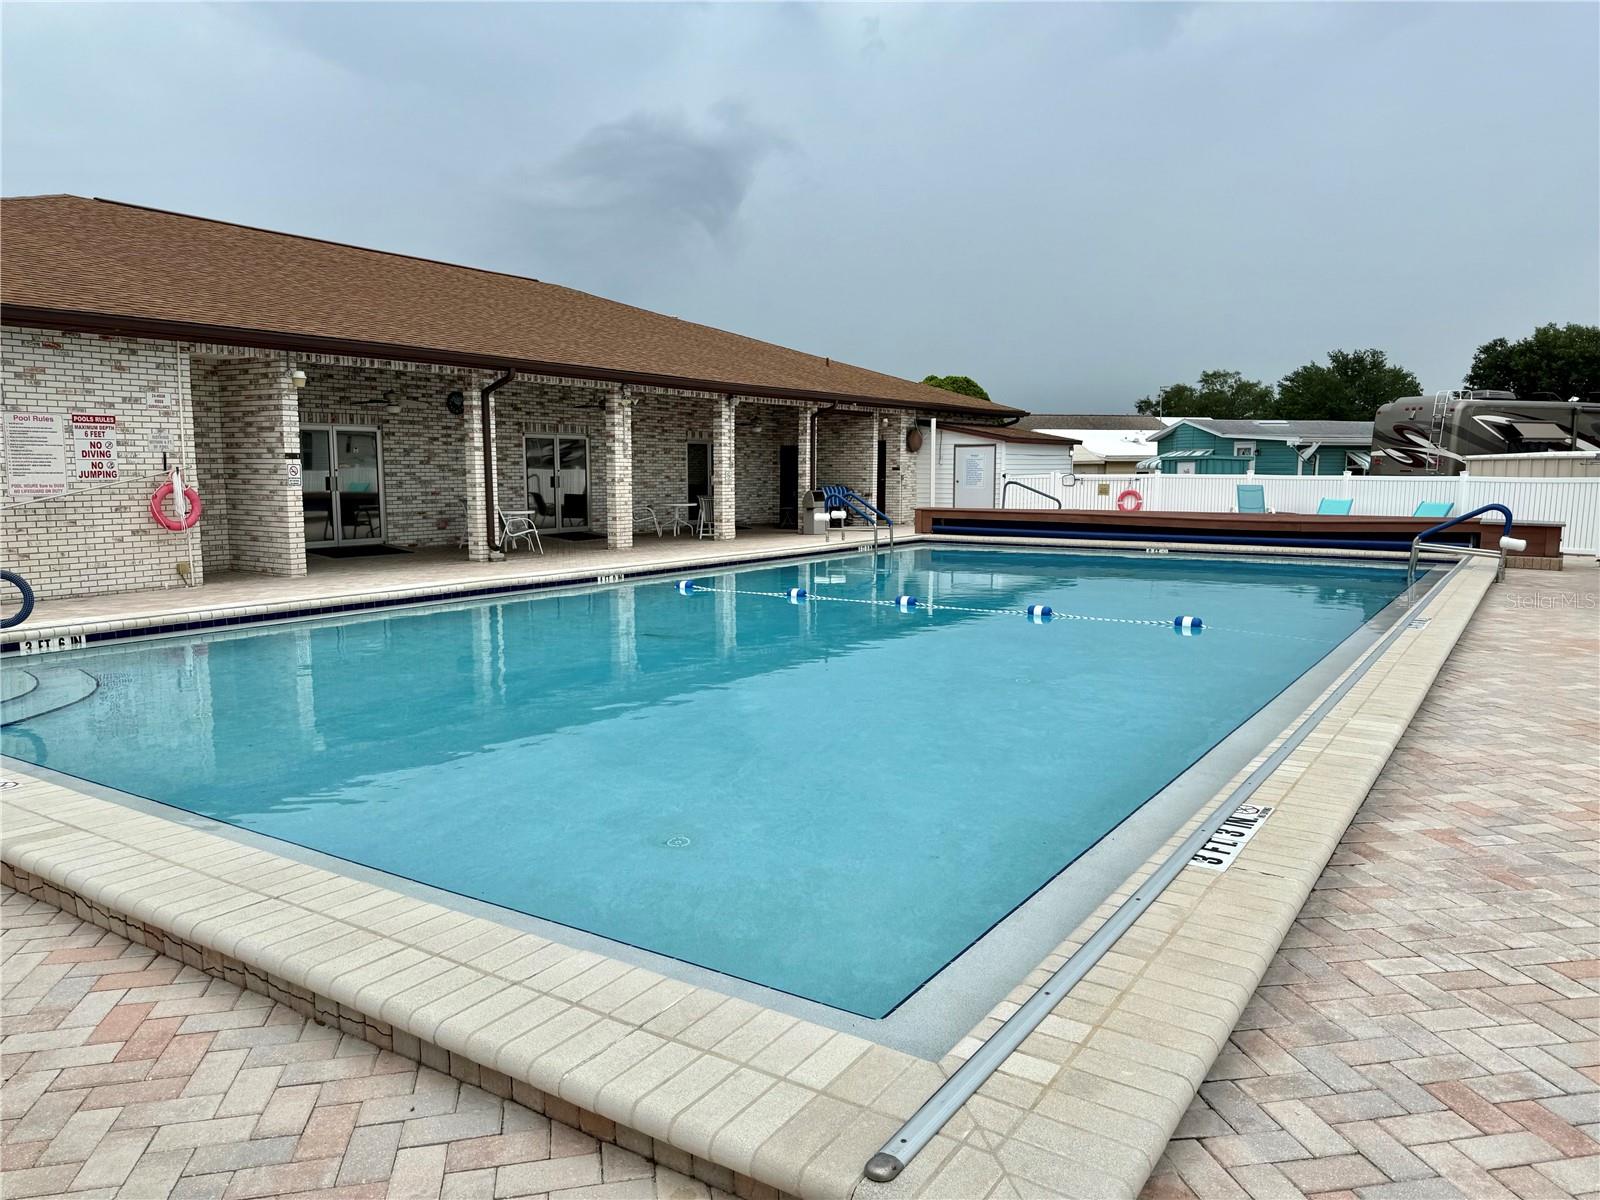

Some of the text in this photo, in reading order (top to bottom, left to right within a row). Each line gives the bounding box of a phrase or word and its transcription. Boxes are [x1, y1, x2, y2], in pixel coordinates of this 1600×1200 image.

[89, 441, 102, 449] NO
[81, 450, 112, 458] DIVING
[78, 470, 118, 479] JUMPING
[38, 639, 51, 649] FT
[70, 635, 82, 645] IN
[1192, 854, 1223, 865] 3
[1216, 828, 1245, 837] 3
